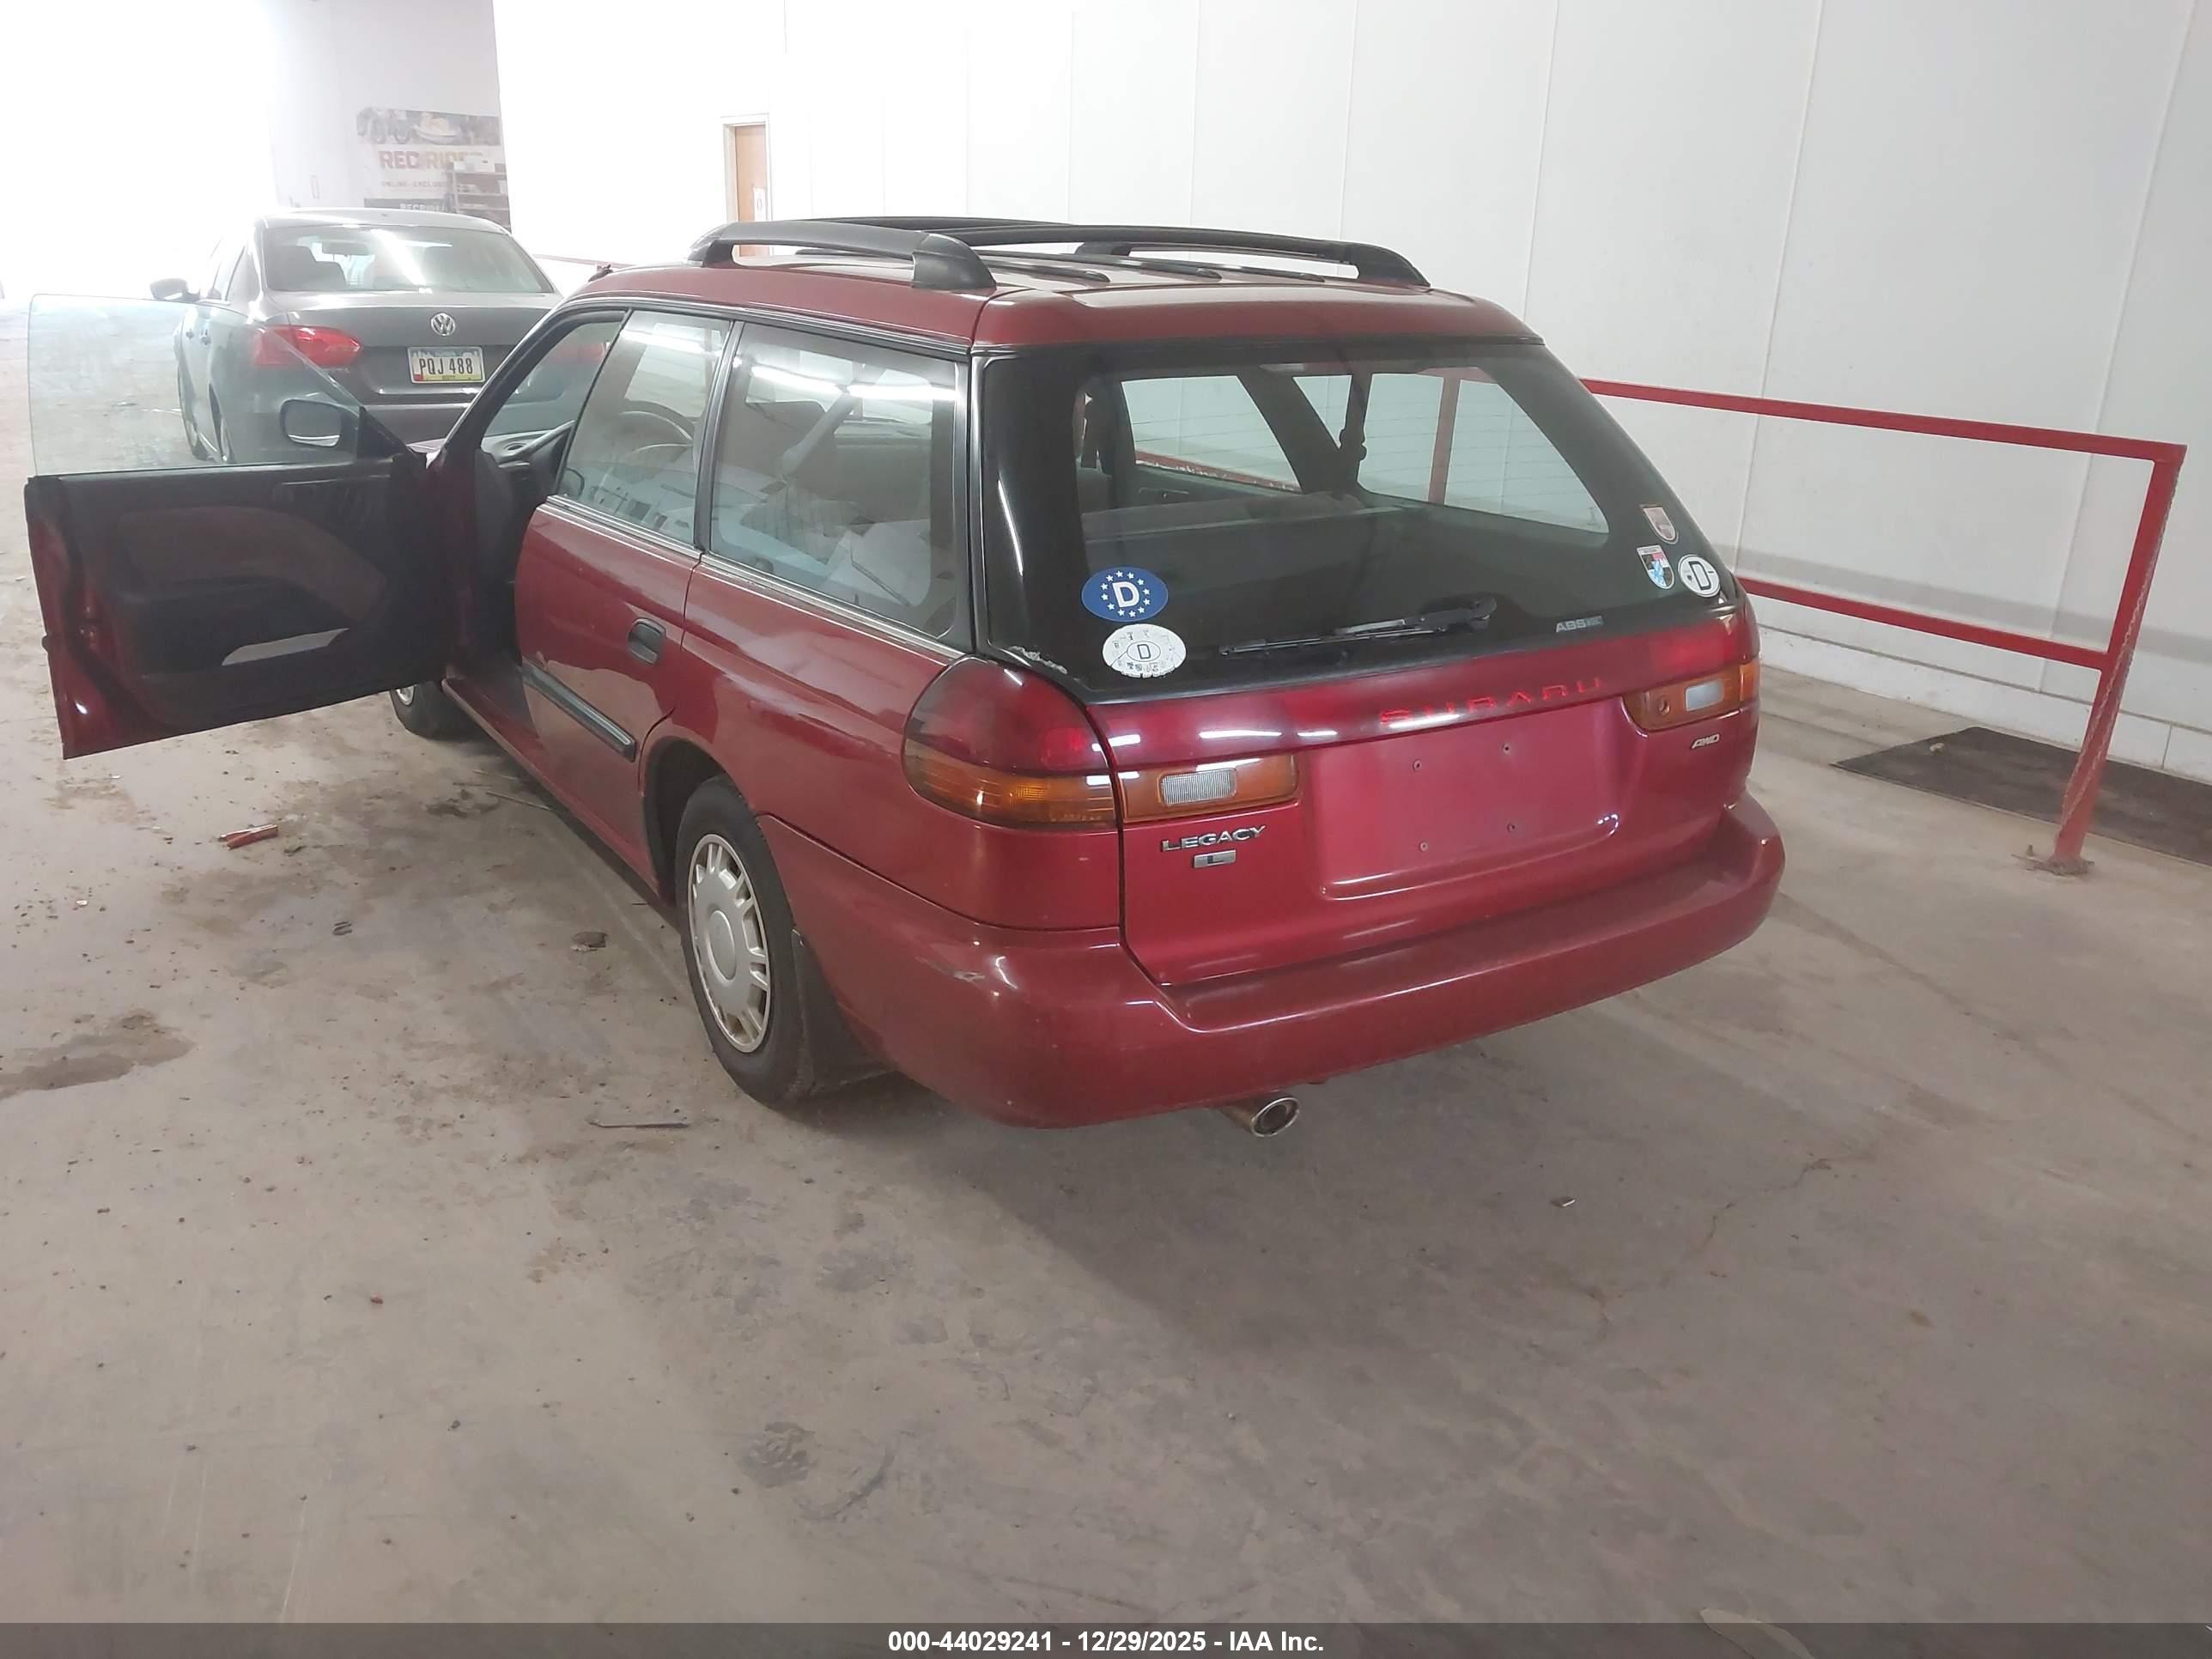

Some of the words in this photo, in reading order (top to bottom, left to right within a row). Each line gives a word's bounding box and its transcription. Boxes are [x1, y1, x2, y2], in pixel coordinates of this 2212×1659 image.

[418, 357, 445, 375] PQJ
[448, 357, 473, 374] 488
[1688, 561, 1712, 591] D
[1112, 580, 1140, 608] D
[1555, 617, 1587, 633] ABS
[1136, 643, 1152, 660] D
[1379, 677, 1603, 727] SUBARU
[1161, 824, 1267, 852] LEGACY
